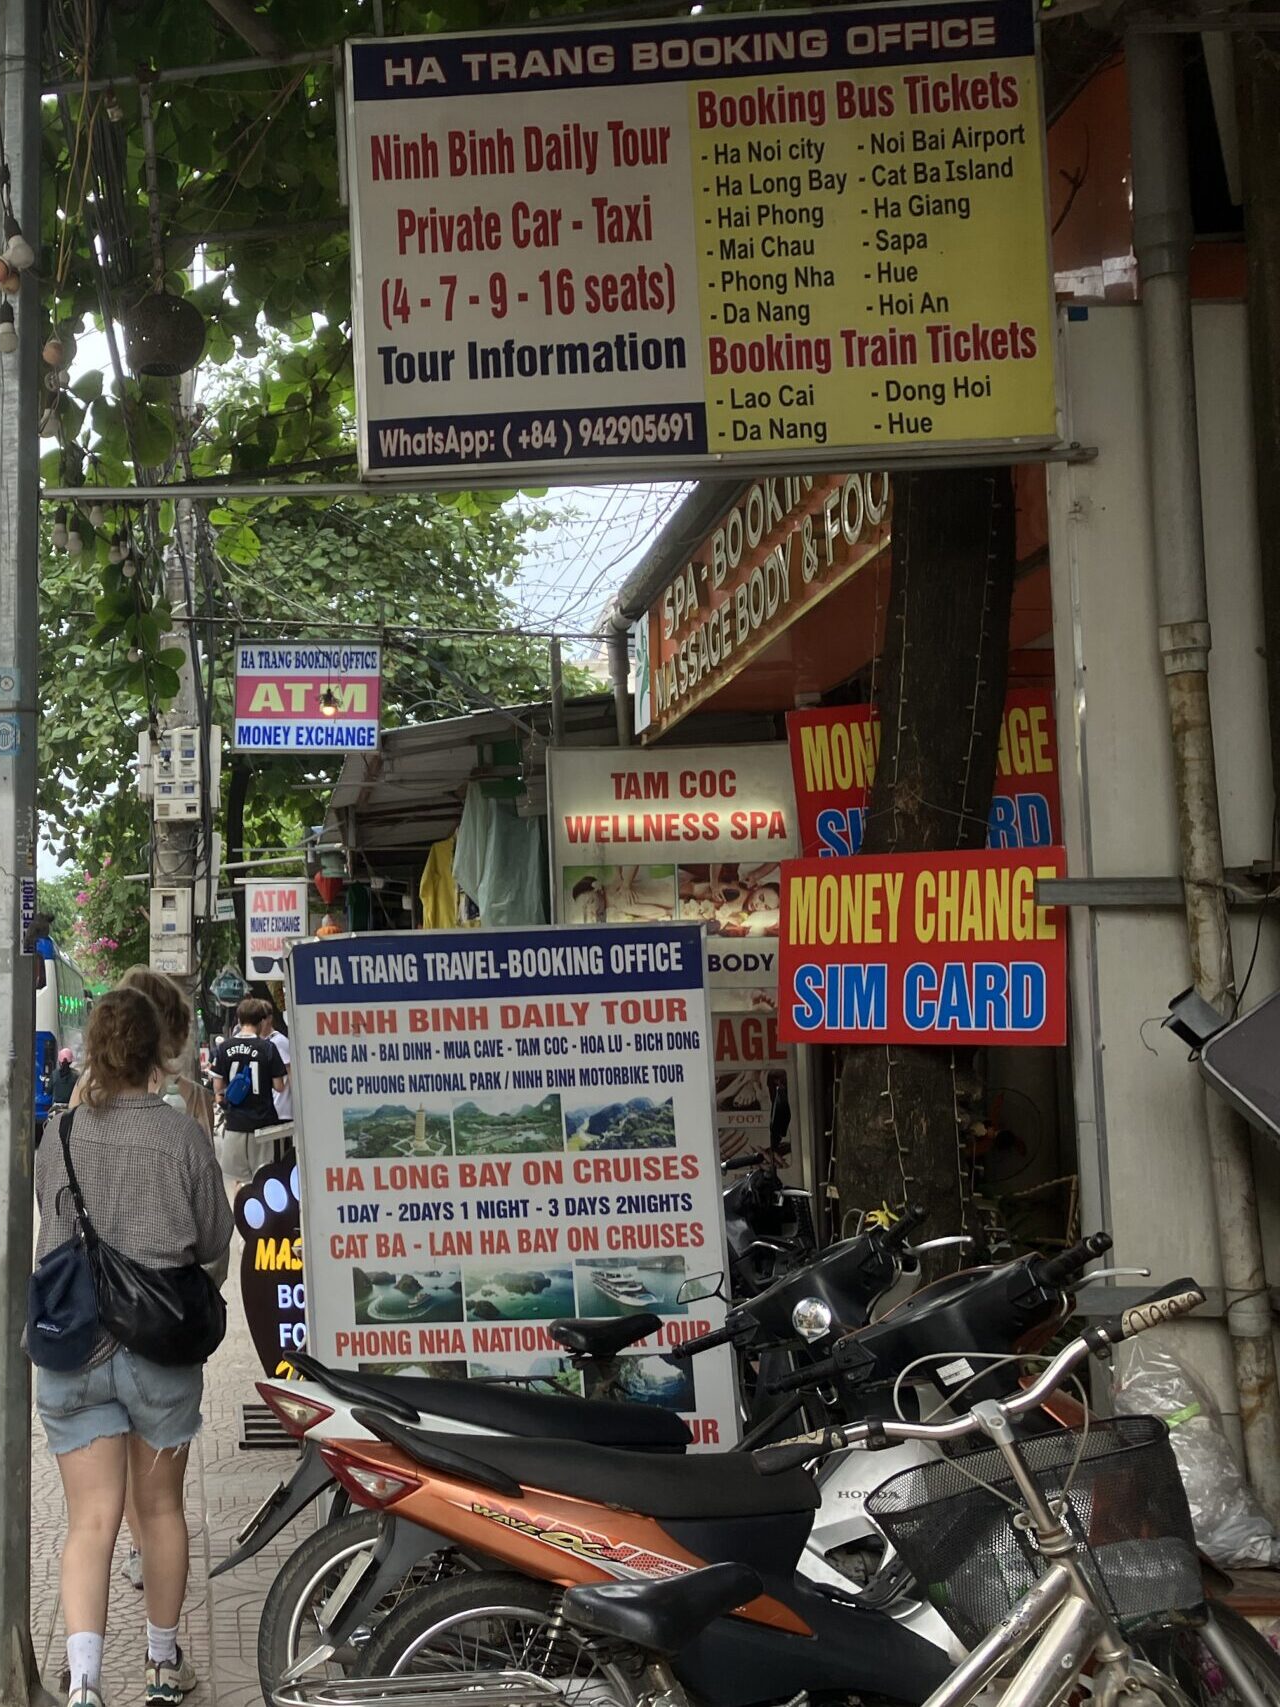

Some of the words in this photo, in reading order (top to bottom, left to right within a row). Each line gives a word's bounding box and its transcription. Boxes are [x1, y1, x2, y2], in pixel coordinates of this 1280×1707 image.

[384, 56, 446, 86] HA
[462, 45, 615, 81] TRANG
[632, 29, 828, 71] BOOKING
[847, 17, 995, 55] OFFICE
[698, 85, 825, 129] Booking
[836, 80, 894, 119] Bus
[904, 71, 1018, 115] Tickets
[371, 133, 438, 181] Ninh
[448, 128, 514, 177] Binh
[524, 123, 598, 175] Daily
[608, 121, 670, 167] Tour
[714, 143, 741, 164] Ha
[748, 139, 781, 163] Noi
[788, 138, 825, 164] city
[871, 132, 905, 155] Noi
[913, 128, 945, 151] Bai
[952, 124, 1025, 149] Airport
[716, 175, 742, 197] Ha
[750, 173, 802, 198] Long
[808, 169, 848, 195] Bay
[872, 165, 907, 187] Cat
[914, 162, 941, 184] Ba
[945, 157, 1014, 182] Island
[718, 206, 750, 229] Hai
[758, 204, 824, 229] Phong
[874, 198, 902, 219] Ha
[909, 194, 970, 219] Giang
[397, 206, 501, 255] Private
[512, 201, 562, 249] Car
[592, 195, 652, 243] Taxi
[720, 239, 755, 260] Mai
[761, 236, 815, 258] Chau
[721, 270, 787, 295] Phong
[795, 266, 835, 288] Nha
[723, 303, 750, 324] Da
[758, 301, 810, 325] Nang
[879, 294, 914, 316] Hoi
[920, 292, 949, 313] An
[378, 346, 455, 385] Tour
[468, 332, 686, 380] Information
[708, 333, 832, 375] Booking
[840, 328, 917, 368] Train
[926, 322, 1037, 364] Tickets
[379, 426, 495, 459] WhatsApp:
[579, 413, 693, 447] 942905691
[663, 562, 699, 640] SPA
[655, 599, 732, 717] MASSAGE
[736, 532, 793, 645] BODY
[241, 651, 255, 668] HA
[258, 651, 291, 668] TRANG
[294, 651, 339, 669] BOOKING
[342, 651, 377, 669] OFFICE
[248, 682, 368, 713] ATM
[238, 726, 290, 745] MONEY
[296, 726, 375, 746] EXCHANGE
[611, 771, 669, 800] TAM
[679, 769, 736, 798] COC
[565, 812, 720, 843] WELLNESS
[730, 811, 787, 841] SPA
[252, 889, 297, 912] ATM
[789, 872, 904, 945] MONEY
[915, 865, 1056, 943] CHANGE
[250, 917, 270, 932] MONEY
[271, 916, 300, 932] EXCHANGE
[314, 956, 344, 985] HA
[348, 953, 418, 984] TRANG
[610, 942, 683, 974] OFFICE
[708, 953, 774, 972] BODY
[792, 963, 887, 1030] SIM
[903, 961, 1046, 1031] CARD
[316, 1009, 397, 1036] NINH
[409, 1006, 489, 1033] BINH
[500, 1002, 590, 1029] DAILY
[601, 998, 687, 1025] TOUR
[309, 1045, 347, 1064] TRANG
[351, 1044, 368, 1062] AN
[379, 1043, 399, 1062] BAI
[403, 1042, 432, 1061] DINH
[443, 1041, 470, 1059] MUA
[474, 1039, 504, 1058] CAVE
[515, 1038, 540, 1056] TAM
[544, 1036, 568, 1055] COC
[580, 1035, 605, 1054] HOA
[608, 1035, 623, 1053] LU
[635, 1033, 663, 1052] BICH
[667, 1031, 700, 1050] DONG
[329, 1076, 353, 1095] CUC
[356, 1075, 405, 1094] PHUONG
[408, 1073, 467, 1093] NATIONAL
[470, 1072, 501, 1091] PARK
[512, 1070, 543, 1089] NINH
[546, 1069, 576, 1087] BINH
[580, 1065, 649, 1087] MOTORBIKE
[652, 1064, 684, 1084] TOUR
[728, 1114, 764, 1124] FOOT
[326, 1167, 364, 1192] HA
[374, 1164, 449, 1190] LONG
[458, 1162, 512, 1188] BAY
[523, 1160, 563, 1185] ON
[573, 1155, 699, 1184] CRUISES
[337, 1204, 380, 1223] 1DAY
[399, 1202, 454, 1222] 2DAYS
[476, 1199, 529, 1219] NIGHT
[565, 1196, 610, 1216] DAYS
[616, 1193, 693, 1214] 2NIGHTS
[330, 1234, 368, 1259] CAT
[376, 1233, 407, 1258] BA
[429, 1231, 473, 1256] LAN
[480, 1229, 511, 1255] HA
[517, 1227, 559, 1254] BAY
[567, 1226, 599, 1251] ON
[606, 1222, 705, 1250] CRUISES
[335, 1330, 412, 1356] PHONG
[419, 1328, 466, 1354] NHA
[838, 1490, 900, 1499] HONDA
